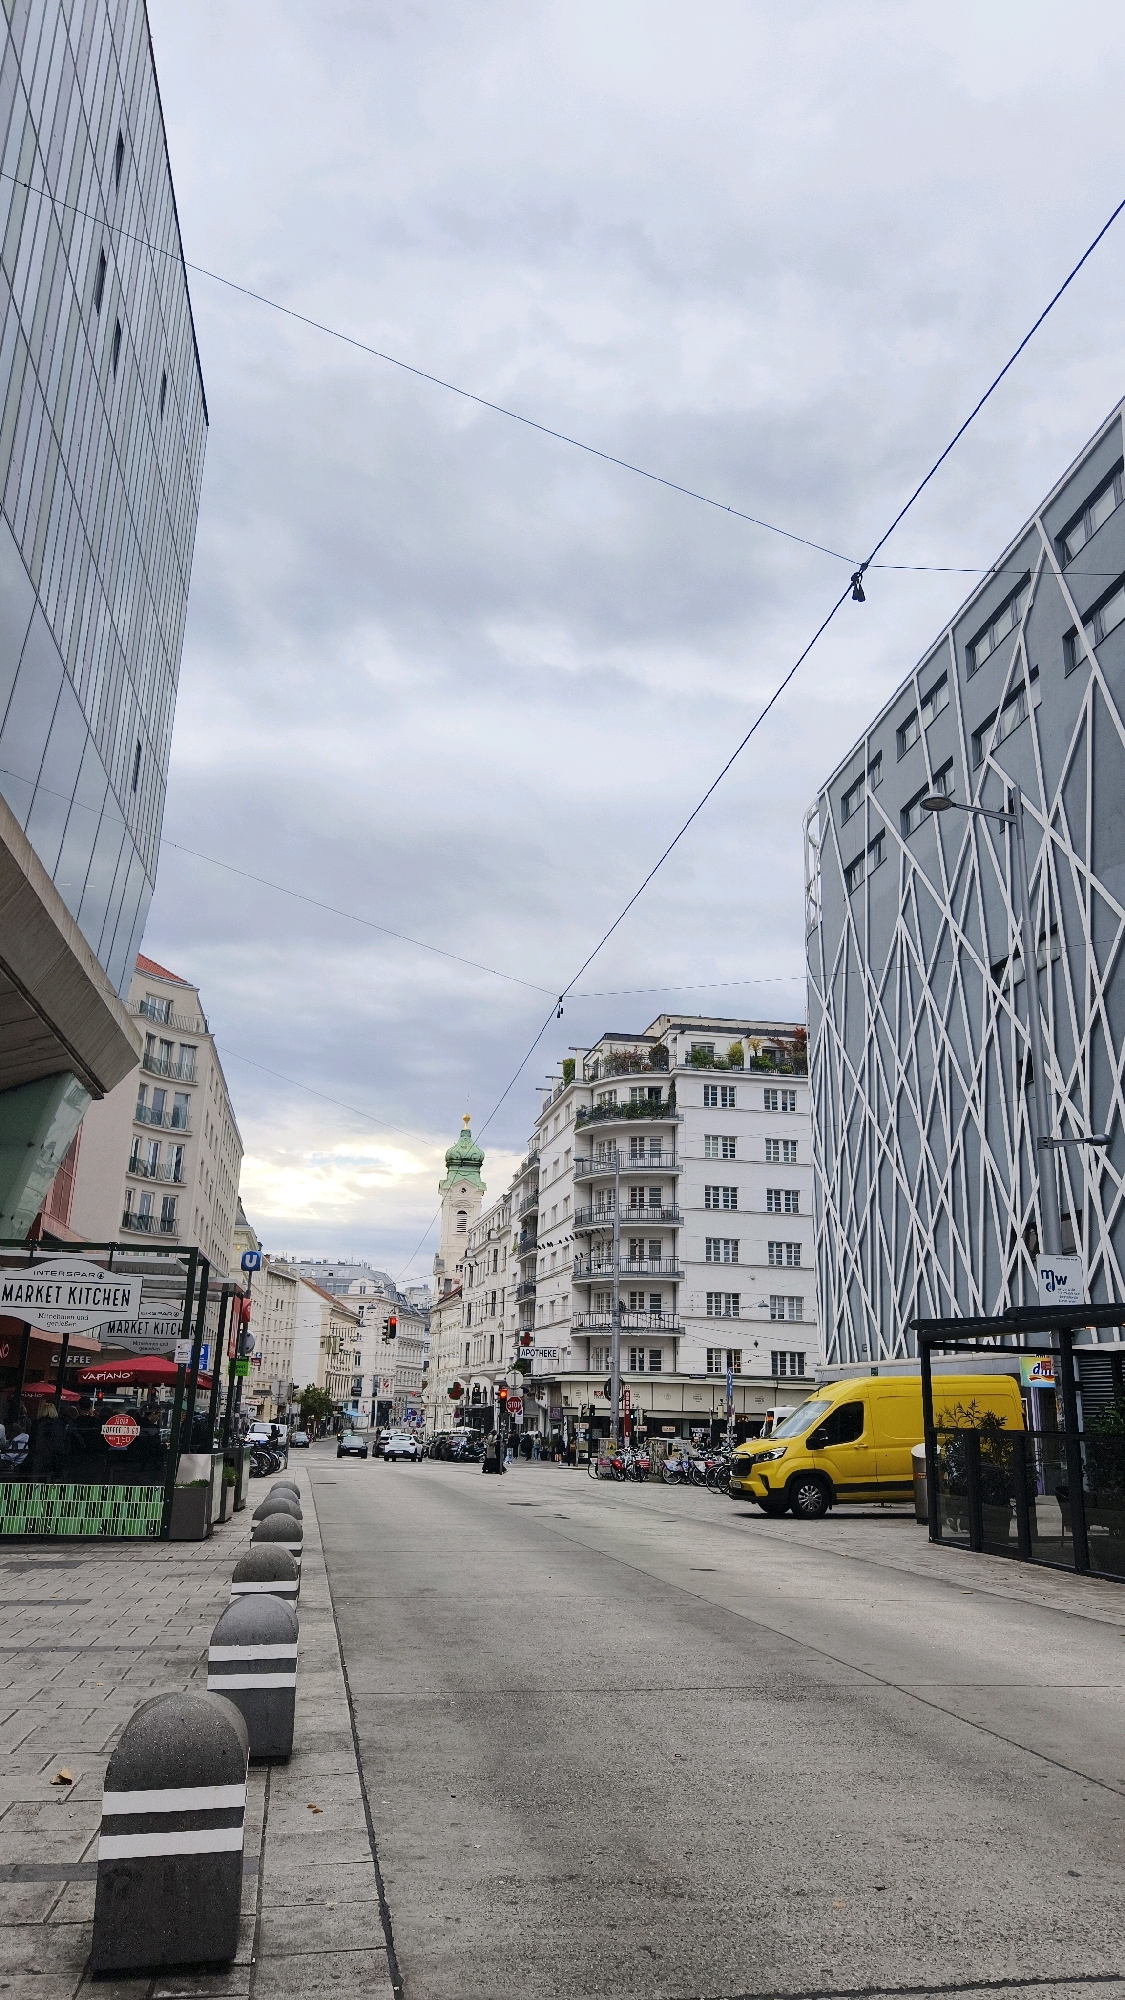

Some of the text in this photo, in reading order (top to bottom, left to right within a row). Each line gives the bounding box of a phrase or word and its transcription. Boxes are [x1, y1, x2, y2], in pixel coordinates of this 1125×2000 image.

[245, 1254, 257, 1268] U
[33, 1270, 96, 1278] INTERSPAR
[2, 1283, 131, 1307] MARKET KITCHEN
[106, 1321, 196, 1336] MARKET KITCHN
[51, 1354, 92, 1364] CFFEE
[520, 1348, 557, 1358] APOTHEKE
